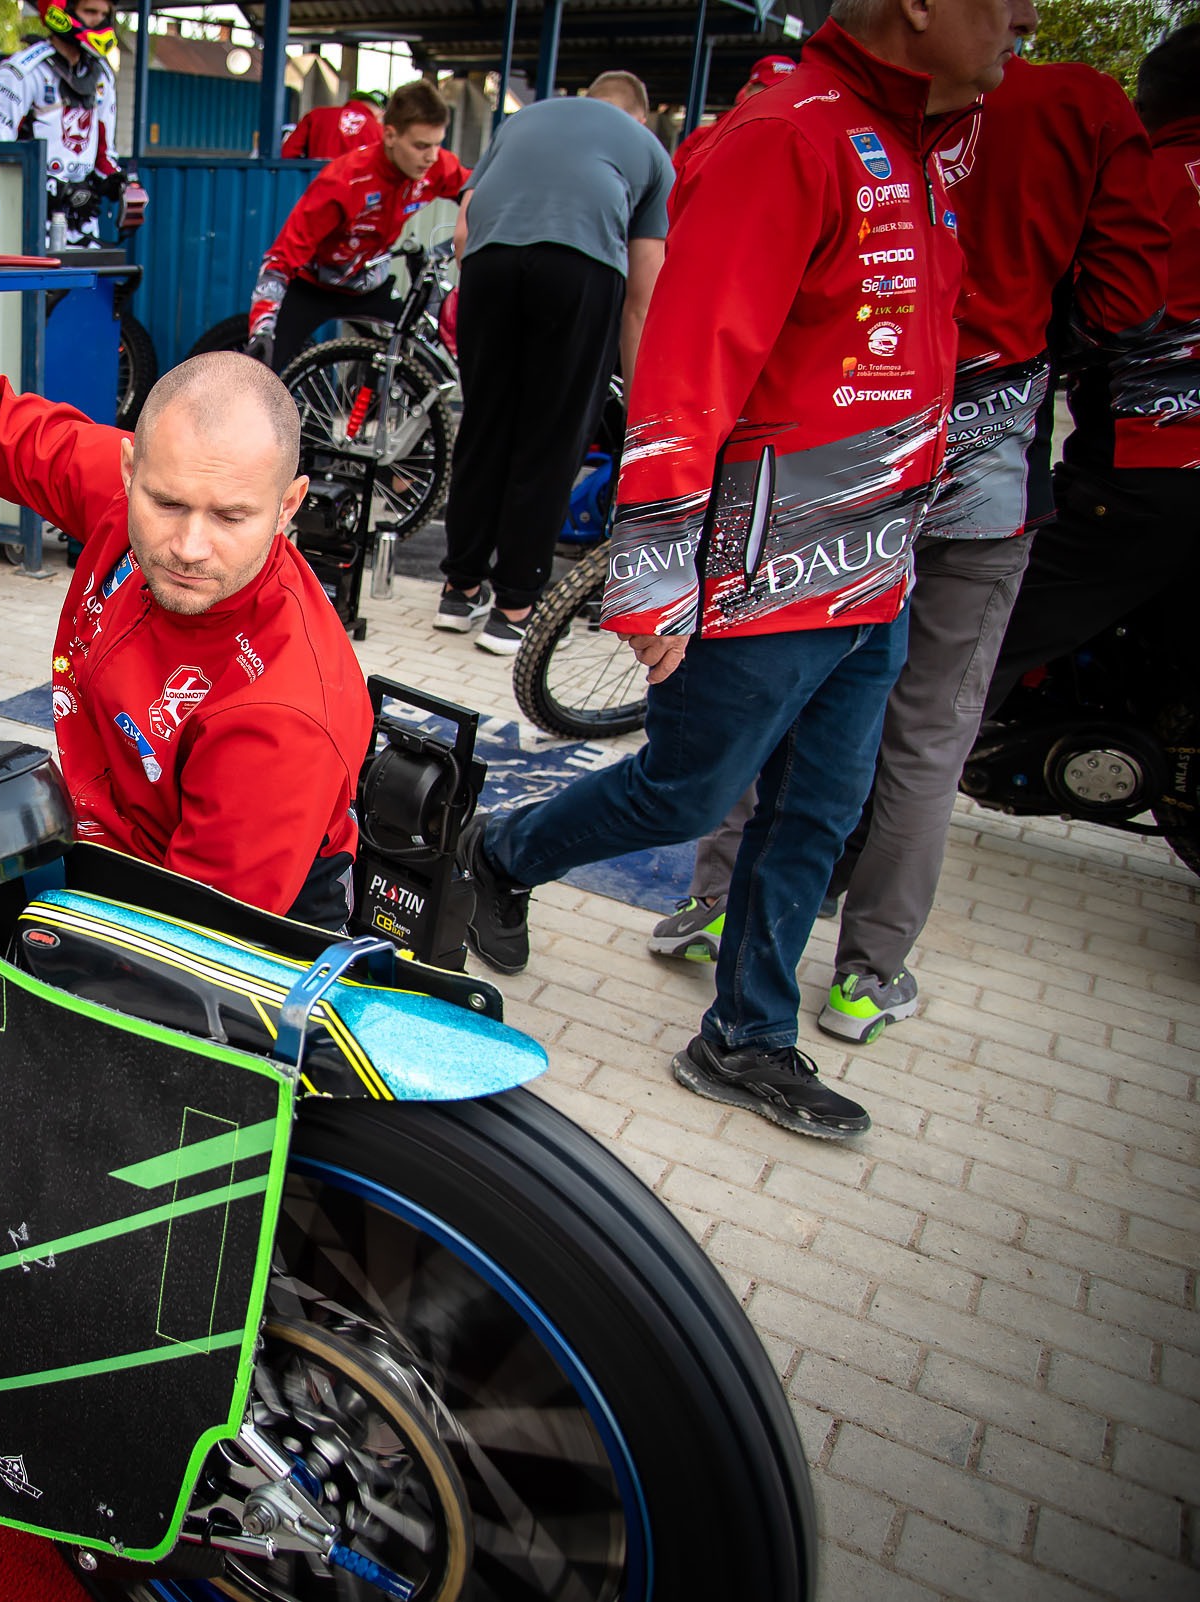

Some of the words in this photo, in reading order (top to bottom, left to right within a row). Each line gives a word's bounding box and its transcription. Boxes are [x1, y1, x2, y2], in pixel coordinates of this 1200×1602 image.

[875, 183, 910, 202] OPTIBET
[859, 248, 914, 266] TRODO
[857, 363, 868, 371] Dr.
[856, 389, 912, 401] STOKKER
[1174, 753, 1190, 793] ANLAS
[370, 874, 425, 914] PLATIN
[376, 914, 393, 931] CB
